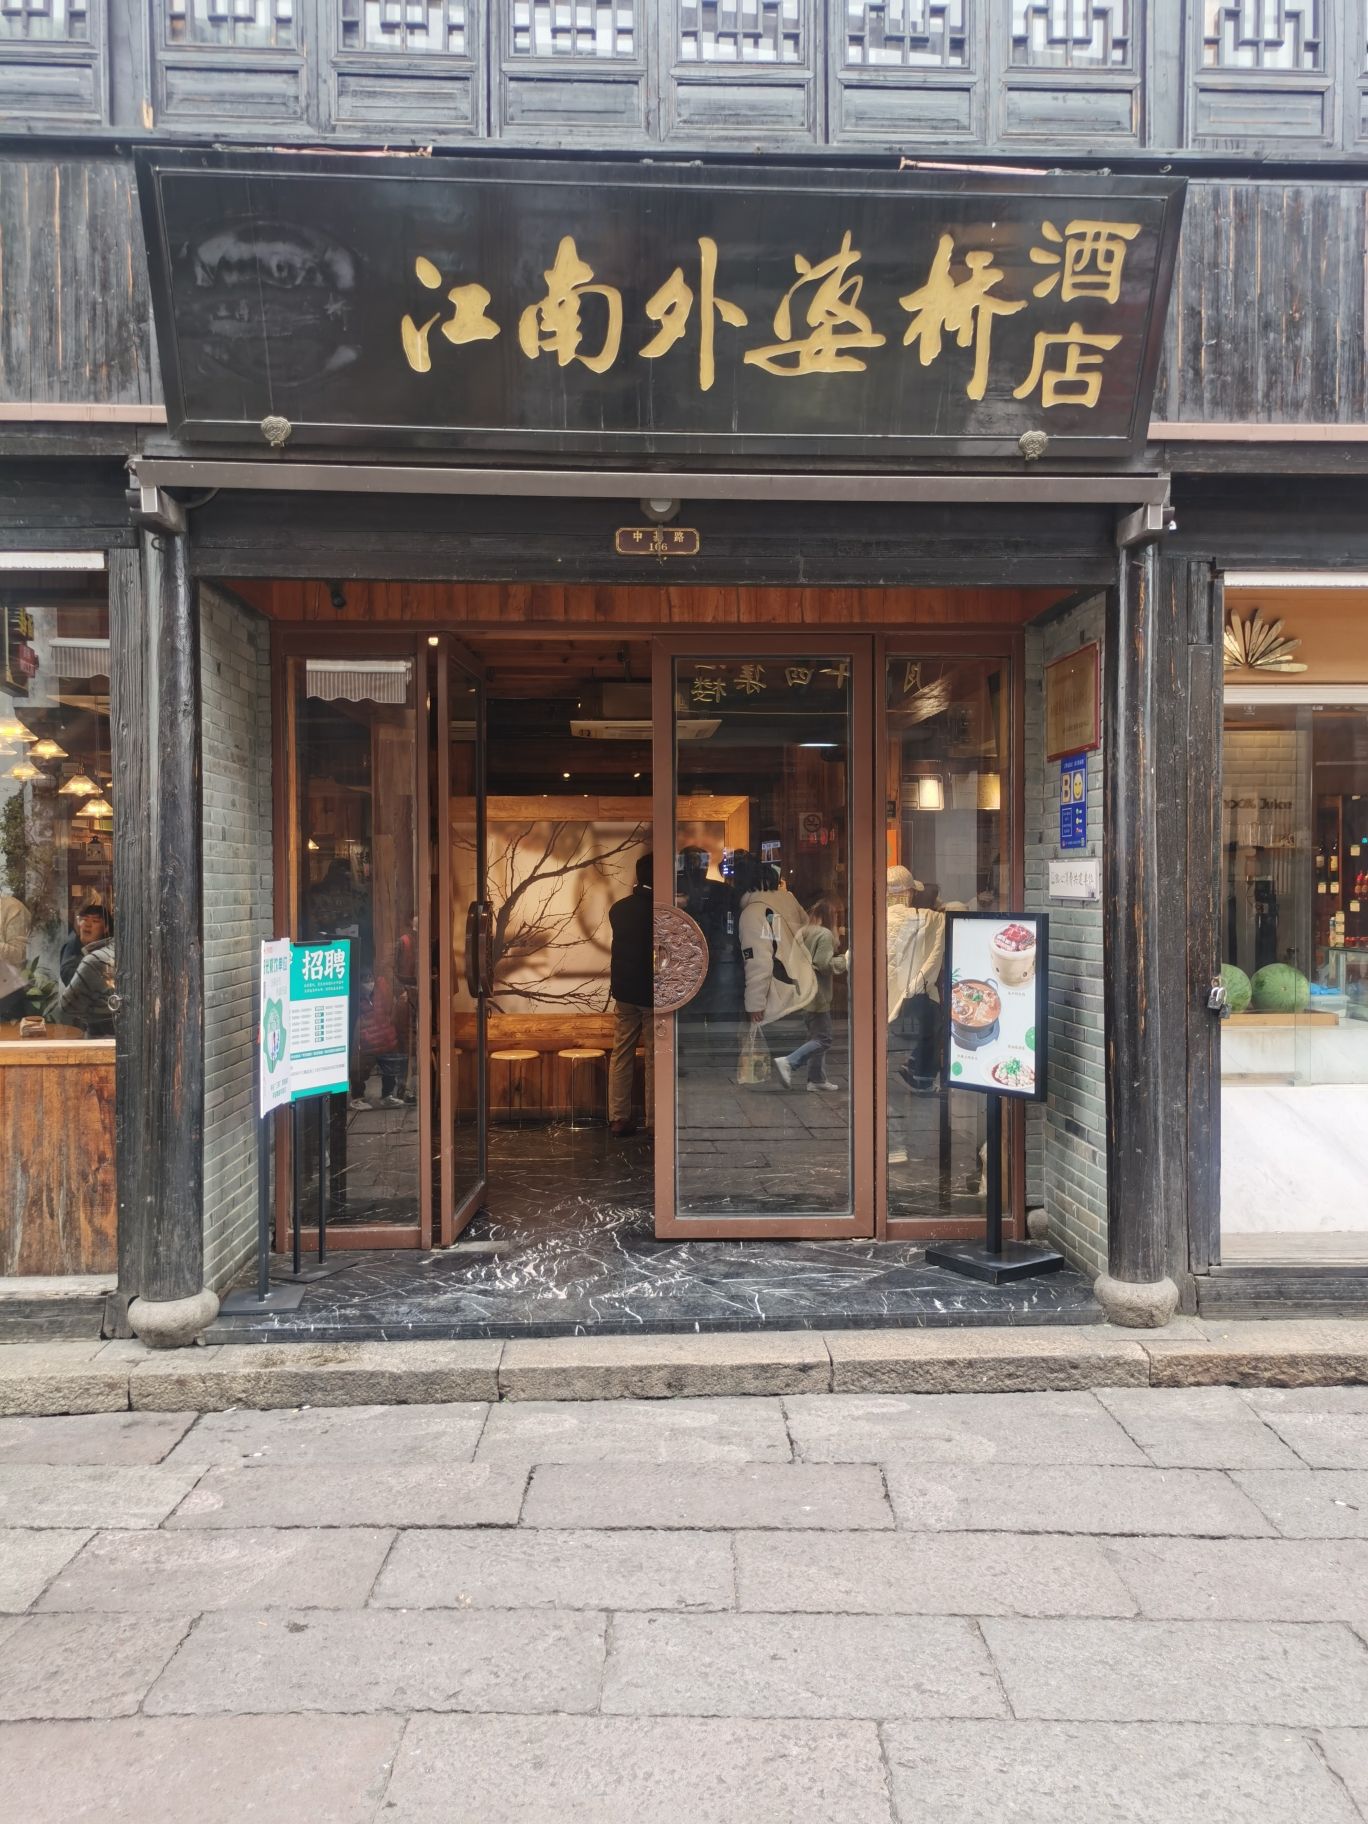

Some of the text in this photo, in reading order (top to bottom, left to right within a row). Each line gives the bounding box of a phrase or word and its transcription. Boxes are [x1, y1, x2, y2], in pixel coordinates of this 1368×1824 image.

[400, 229, 1029, 401] 江南外婆桥
[1013, 219, 1141, 408] 酒店
[1259, 798, 1292, 810] Juice
[302, 949, 346, 981] 招聘
